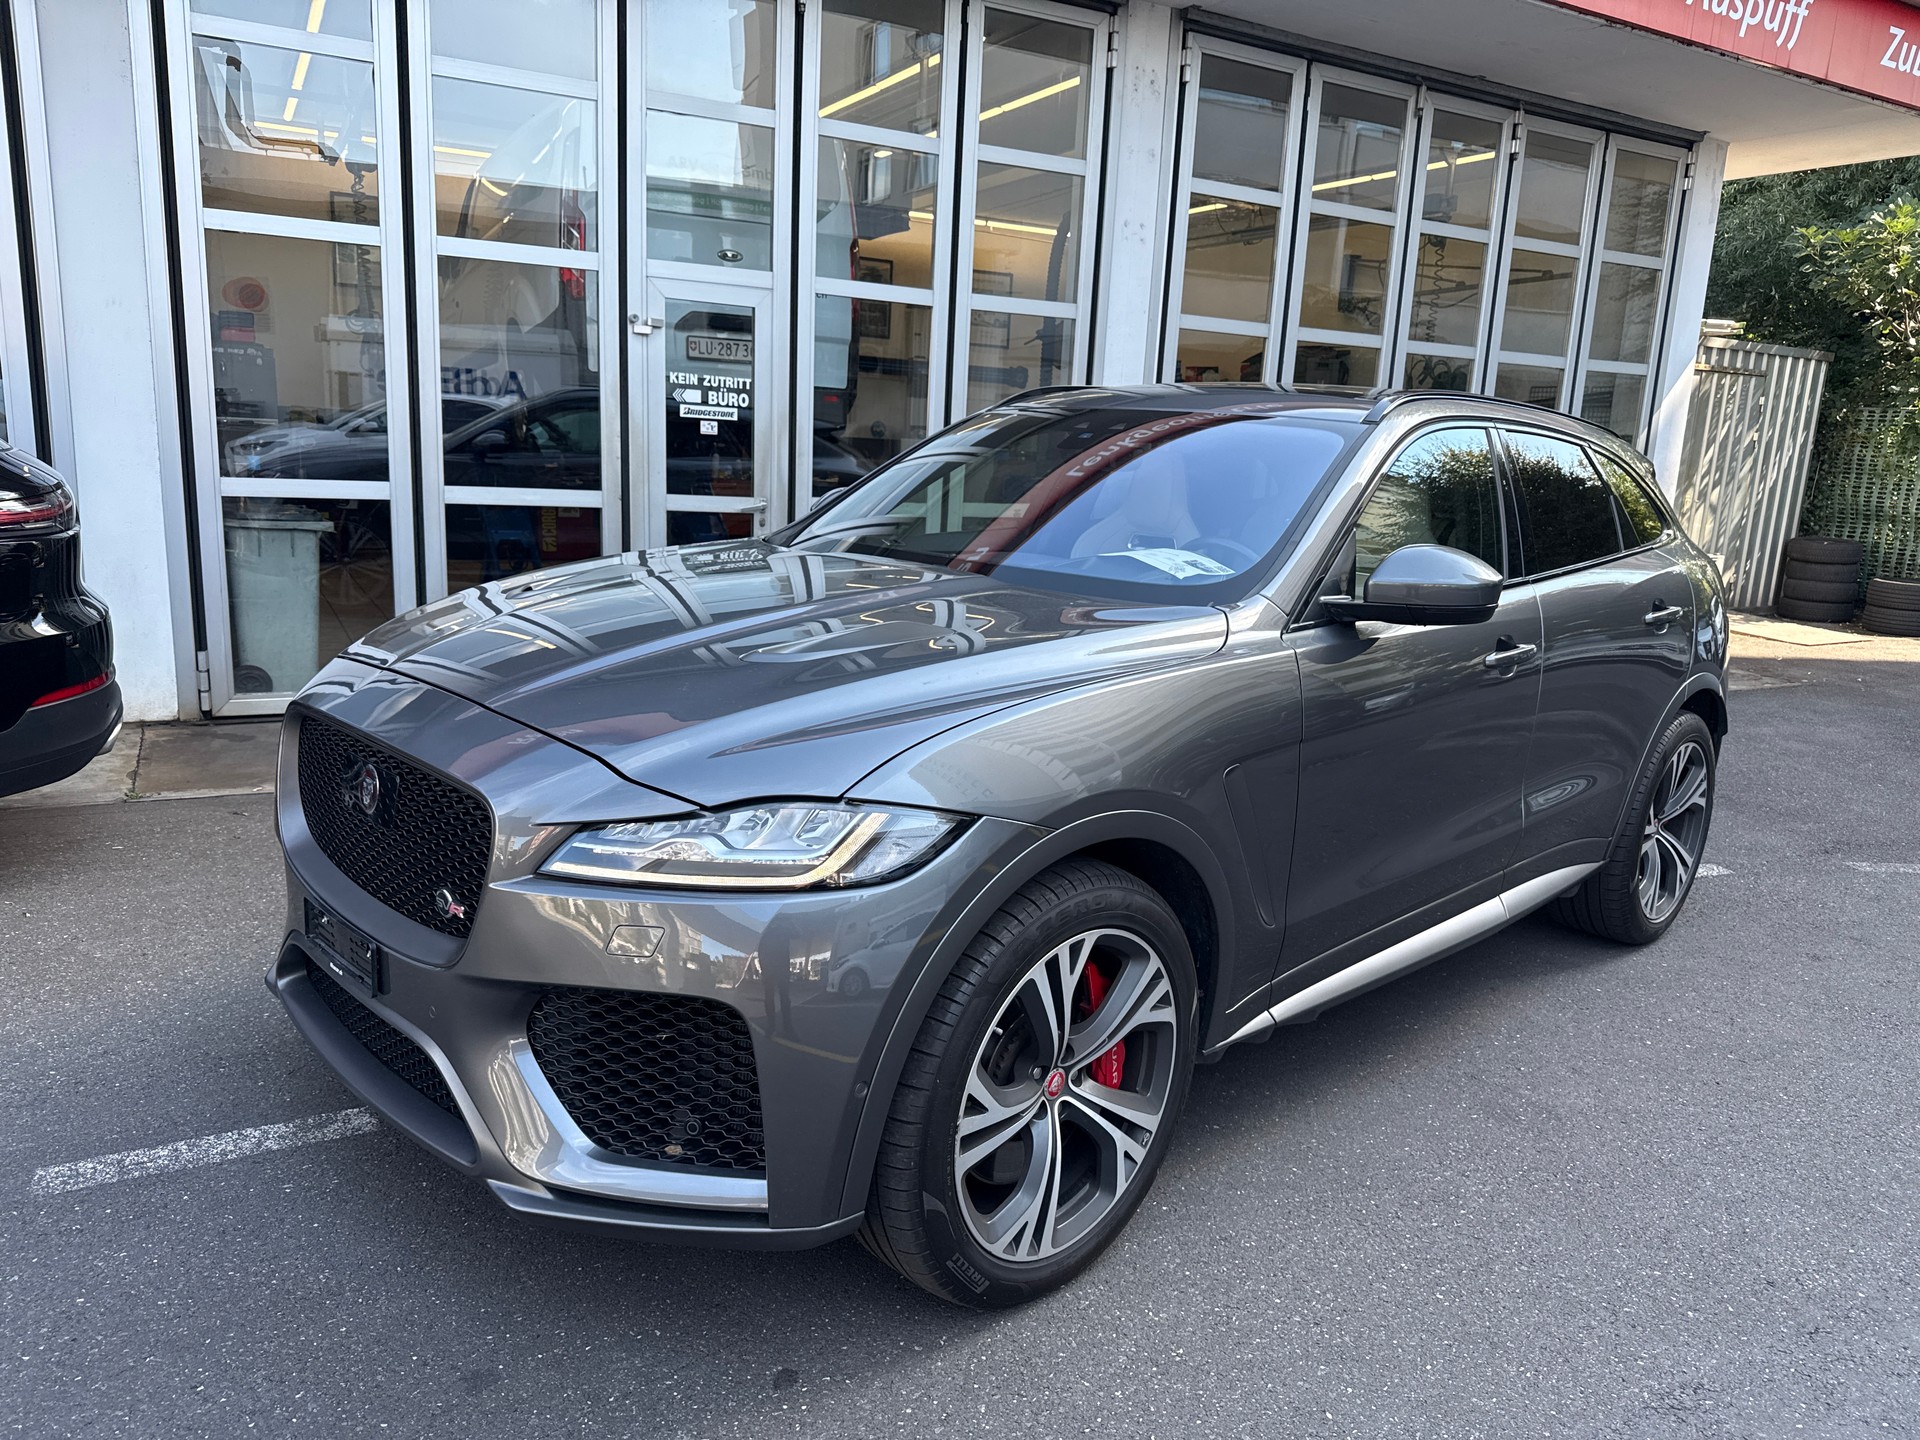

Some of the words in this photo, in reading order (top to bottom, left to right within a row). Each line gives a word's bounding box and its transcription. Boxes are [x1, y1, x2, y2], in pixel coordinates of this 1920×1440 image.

[1686, 0, 1814, 51] uspuff
[669, 371, 698, 385] KEIN
[703, 375, 752, 390] ZUTRITT
[708, 388, 750, 408] BÜRO
[682, 407, 735, 418] BRIDGESTONE
[946, 1252, 990, 1294] PIRELLI
